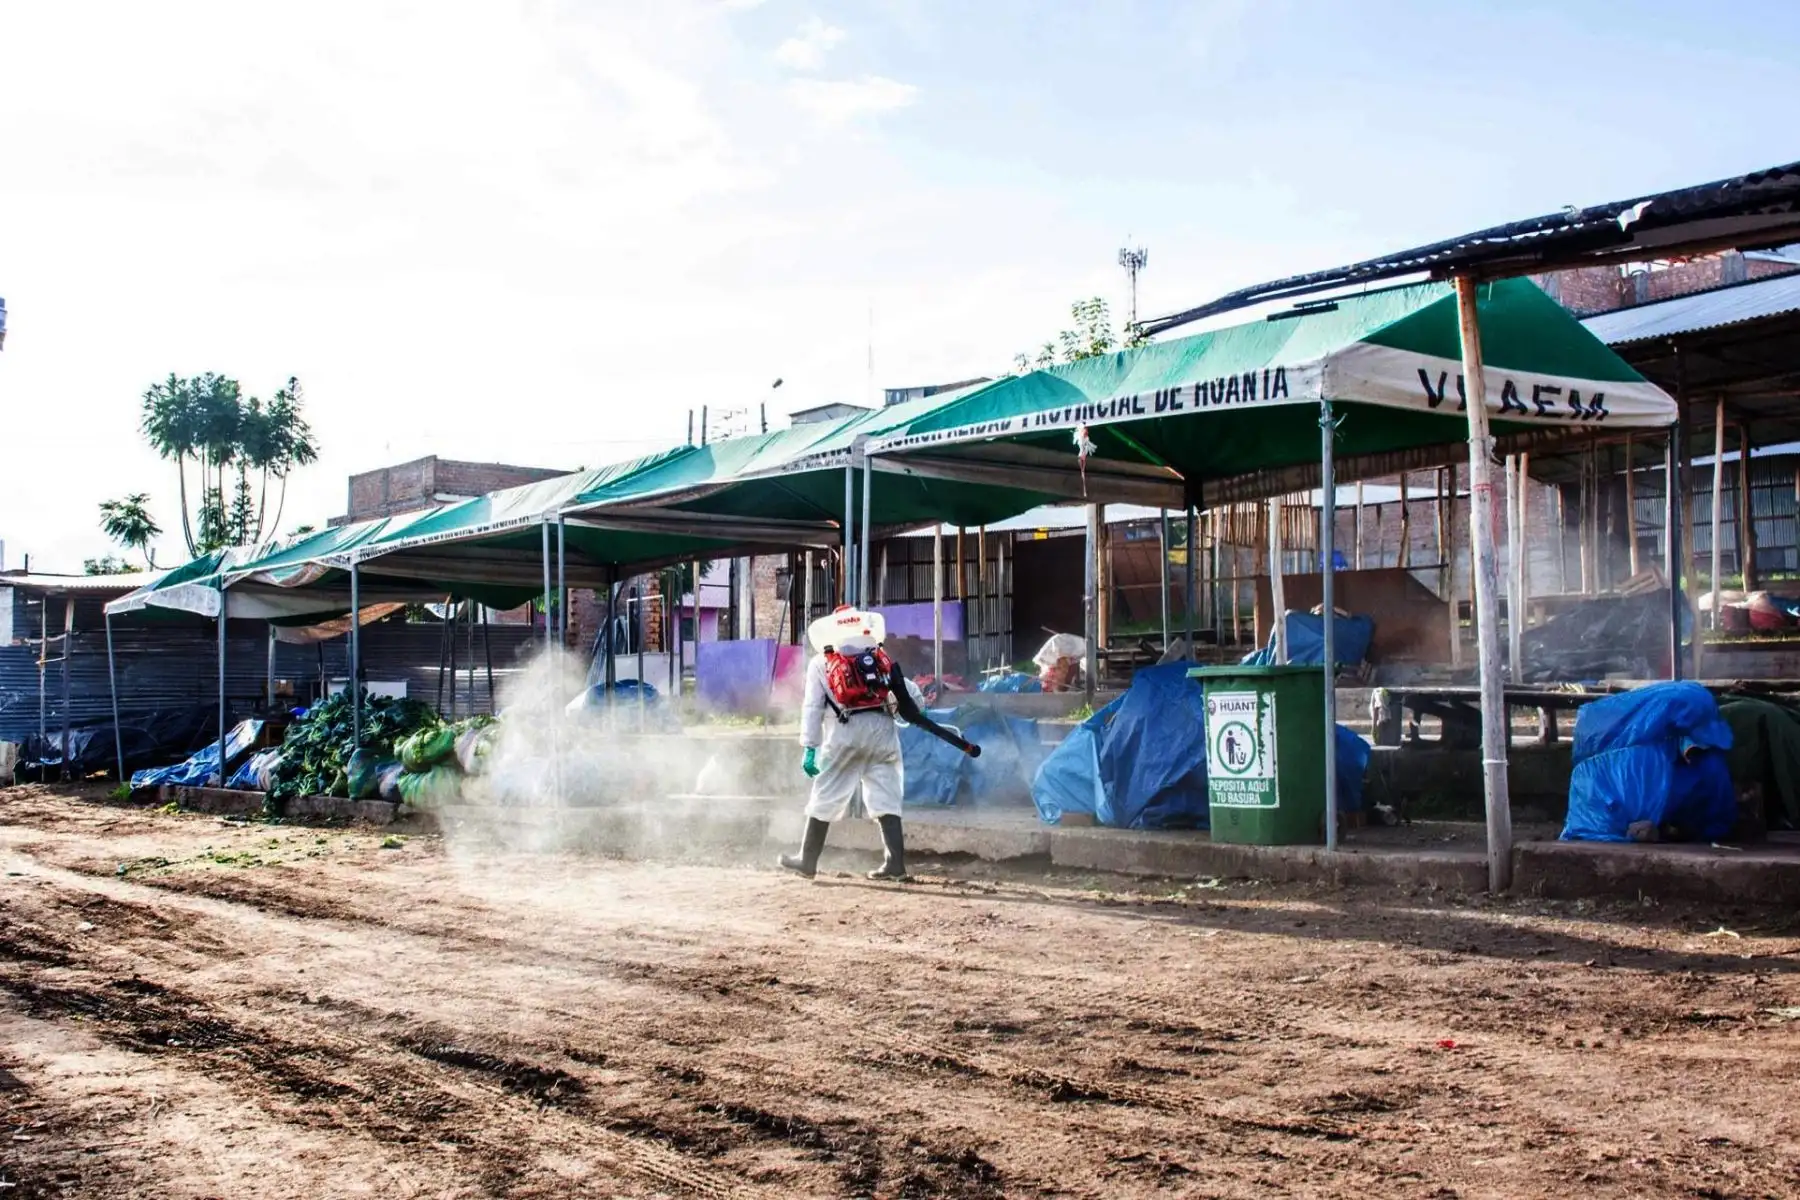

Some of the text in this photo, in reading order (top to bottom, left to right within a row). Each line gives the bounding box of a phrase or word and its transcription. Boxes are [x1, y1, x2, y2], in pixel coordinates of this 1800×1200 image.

[1155, 386, 1183, 412] DE
[1216, 792, 1261, 805] TU BASURA
